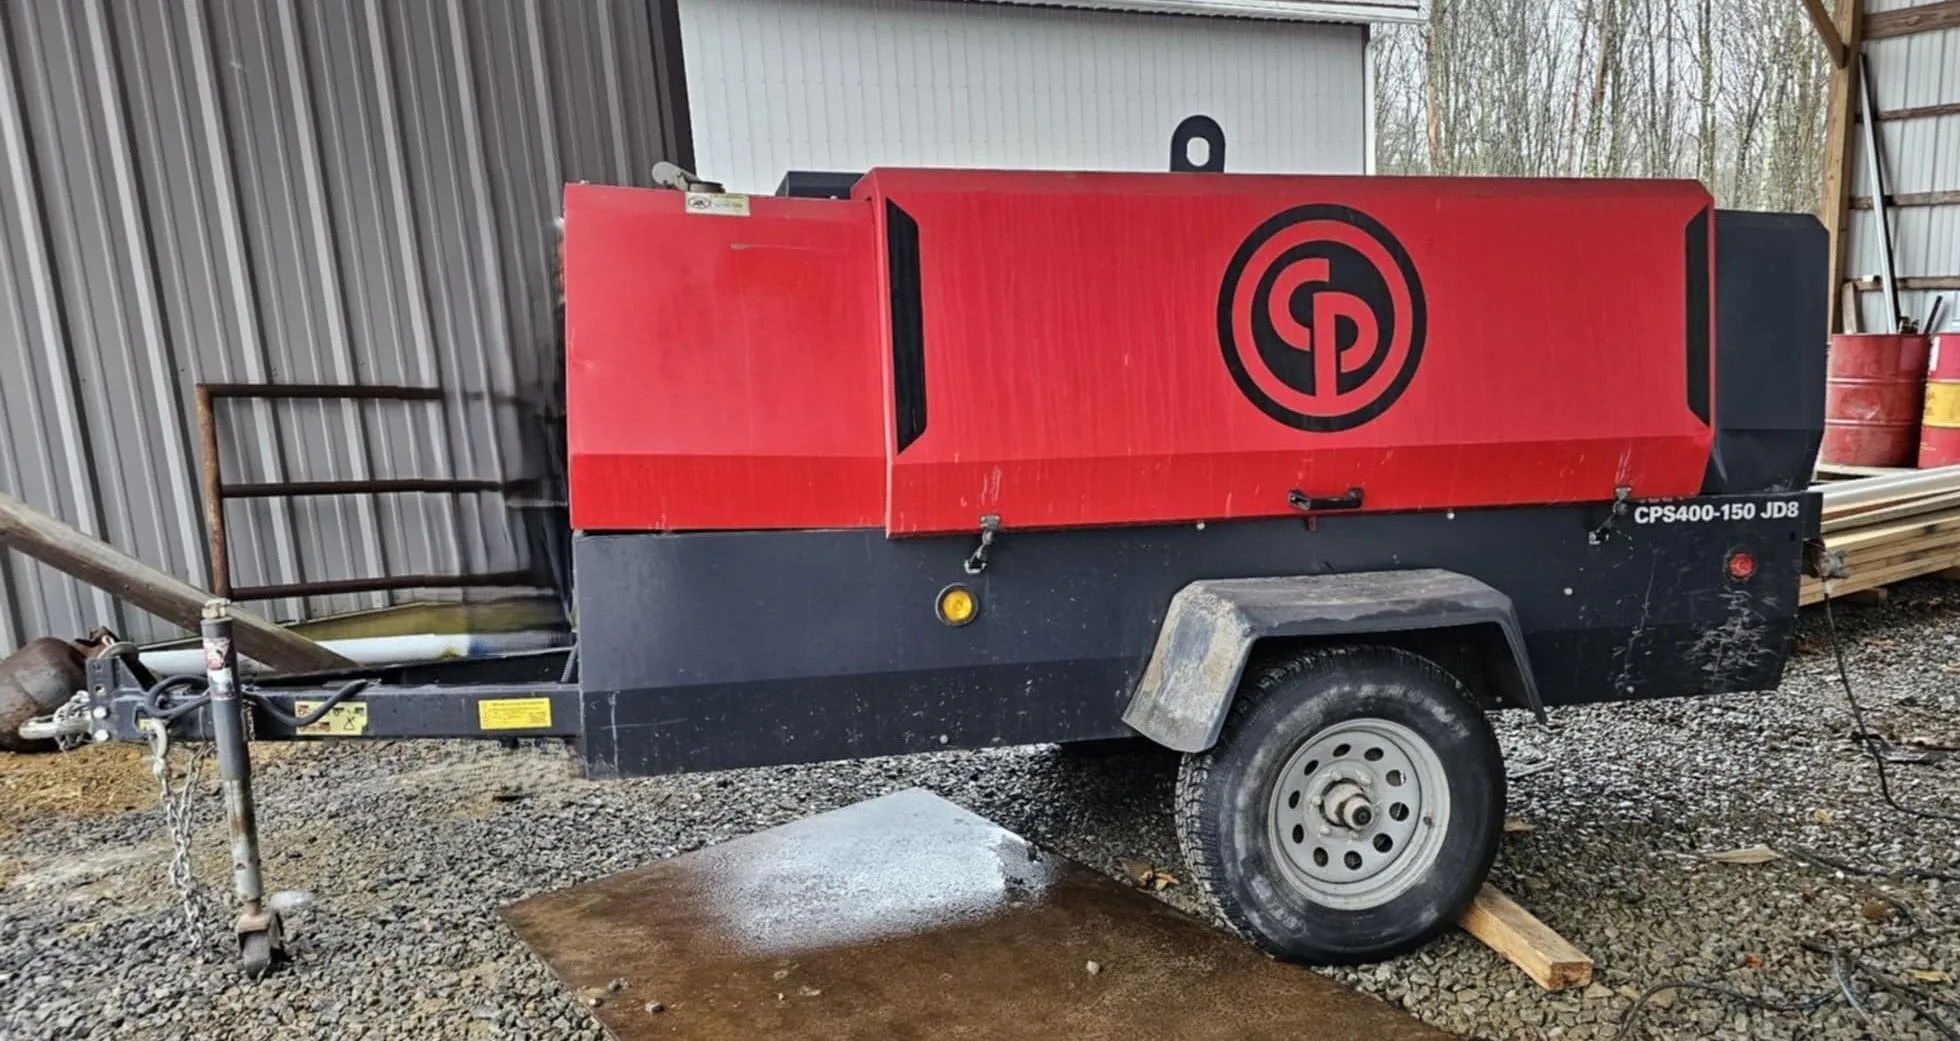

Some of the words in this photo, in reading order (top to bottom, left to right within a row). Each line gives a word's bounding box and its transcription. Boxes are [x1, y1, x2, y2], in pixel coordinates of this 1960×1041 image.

[1268, 257, 1379, 397] CP
[1634, 503, 1755, 524] CPS400-150
[1760, 501, 1799, 519] JD8
